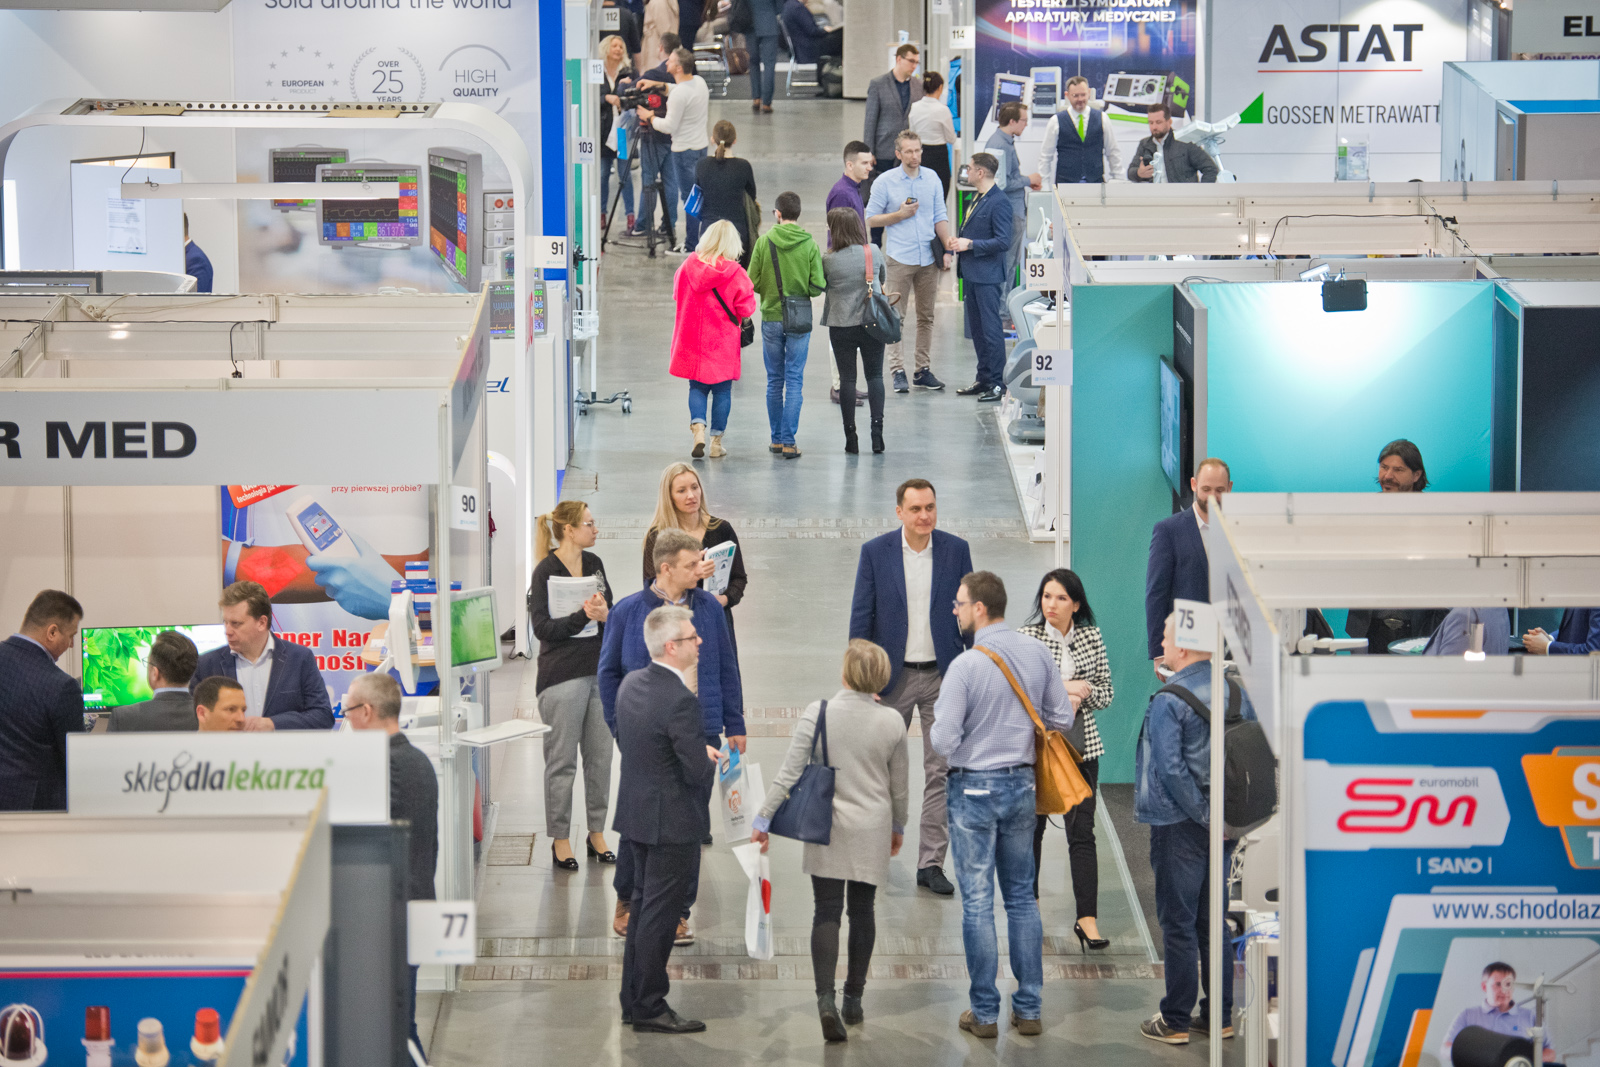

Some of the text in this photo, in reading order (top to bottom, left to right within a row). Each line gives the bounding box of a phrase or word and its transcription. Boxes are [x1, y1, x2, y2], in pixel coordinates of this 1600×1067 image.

[1005, 10, 1176, 23] APARATURY MEDYCZNEJ
[1563, 16, 1600, 36] EL
[952, 30, 965, 39] 114
[1259, 24, 1424, 63] ASTAT
[372, 69, 404, 94] 25
[455, 69, 496, 83] HIGH
[453, 88, 499, 97] QUALITY
[1267, 105, 1440, 124] GOSSEN METRAWATT
[578, 142, 593, 154] 103
[458, 178, 467, 194] 92
[458, 217, 467, 234] 95
[551, 242, 564, 255] 91
[1030, 264, 1045, 277] 93
[1036, 355, 1053, 371] 92
[46, 421, 197, 459] MED
[351, 485, 389, 494] pierwszej
[391, 484, 422, 493] próbie?
[462, 495, 476, 513] 90
[1178, 608, 1194, 629] 75
[1420, 777, 1479, 788] euromobil
[1428, 857, 1483, 874] SANO
[442, 913, 468, 938] 77
